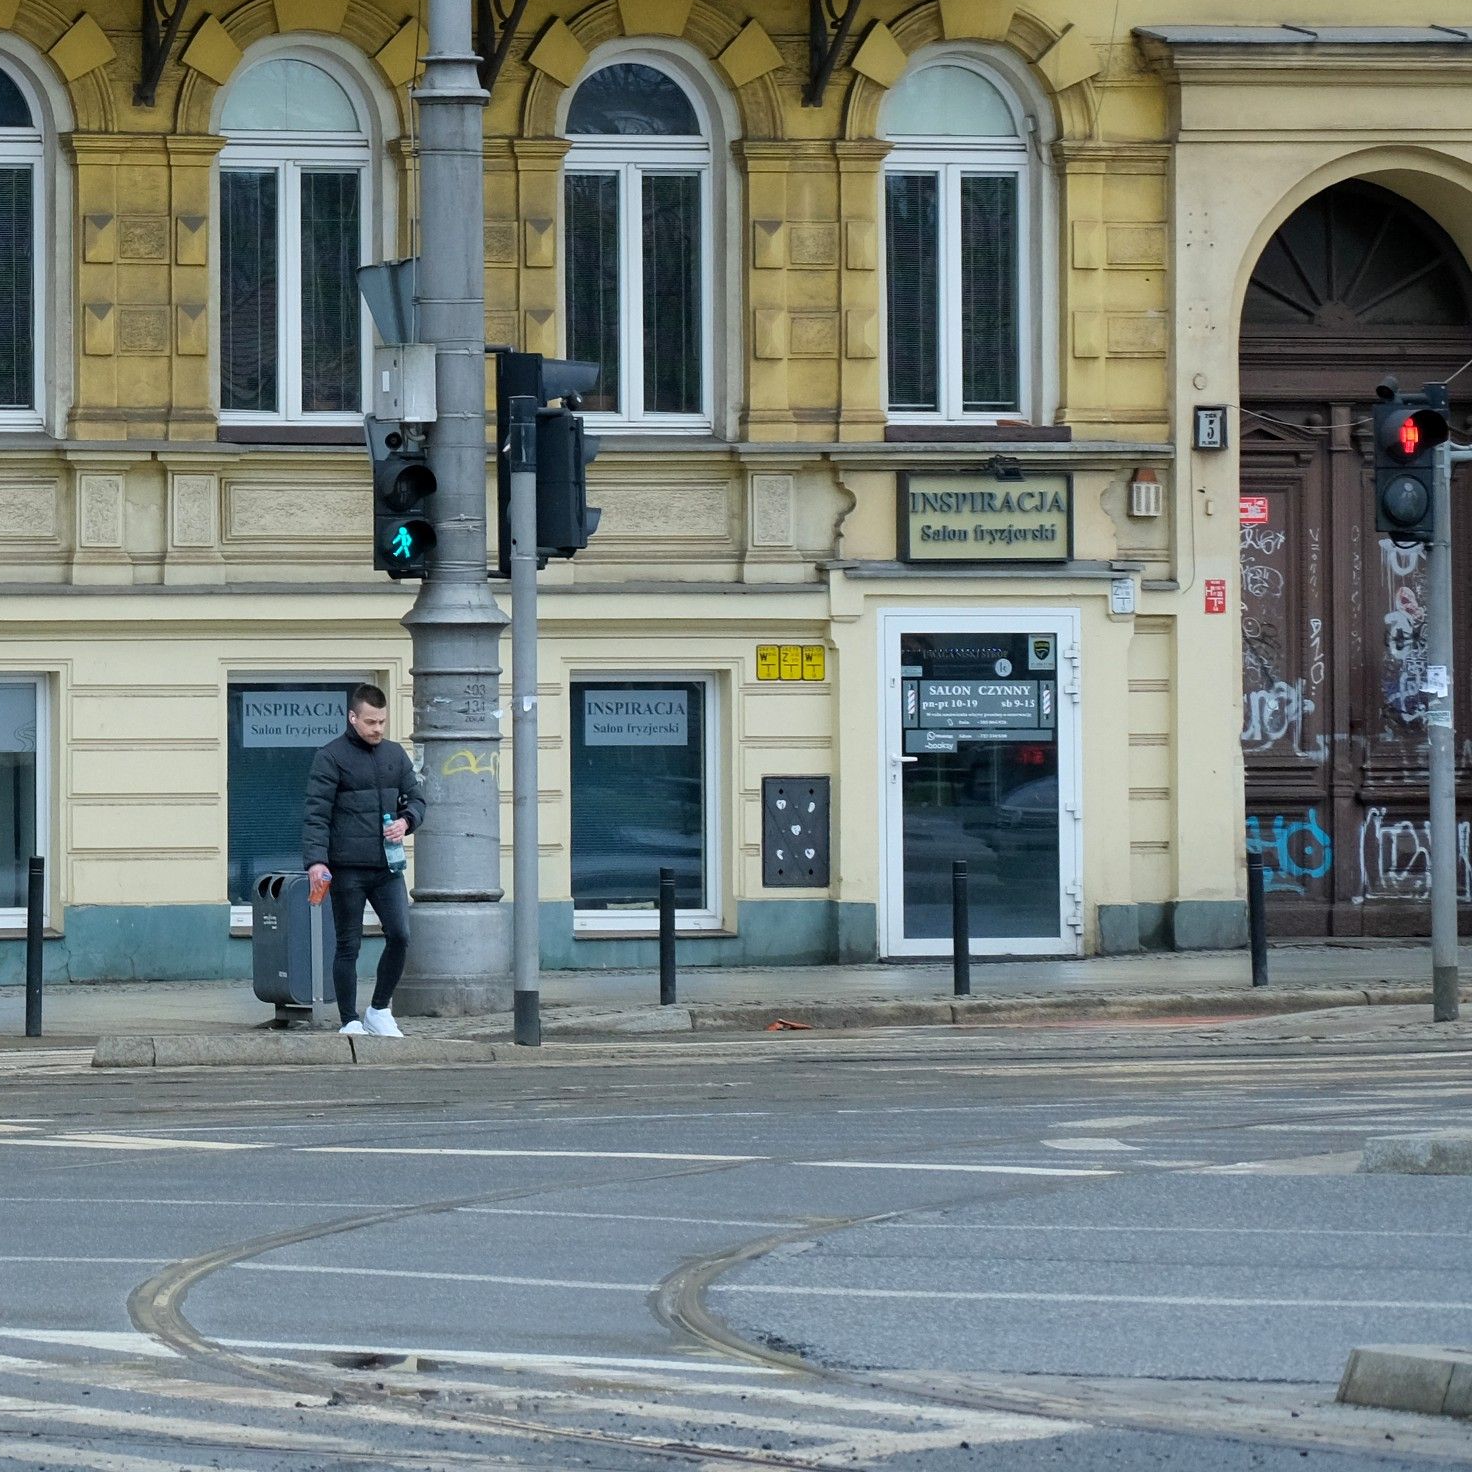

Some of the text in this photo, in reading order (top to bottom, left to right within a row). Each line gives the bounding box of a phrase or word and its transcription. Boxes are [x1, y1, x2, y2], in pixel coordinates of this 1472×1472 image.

[910, 491, 1066, 514] INSPIRACJA
[921, 524, 968, 542] Salon
[929, 685, 1031, 696] SALON CZYNNY
[245, 703, 344, 717] INSPIRACJA
[587, 702, 685, 715] INSPIRACJA
[922, 700, 1035, 710] pn-pt 10-19 sb 9-15
[251, 724, 282, 735] Salon
[593, 723, 623, 734] Salon
